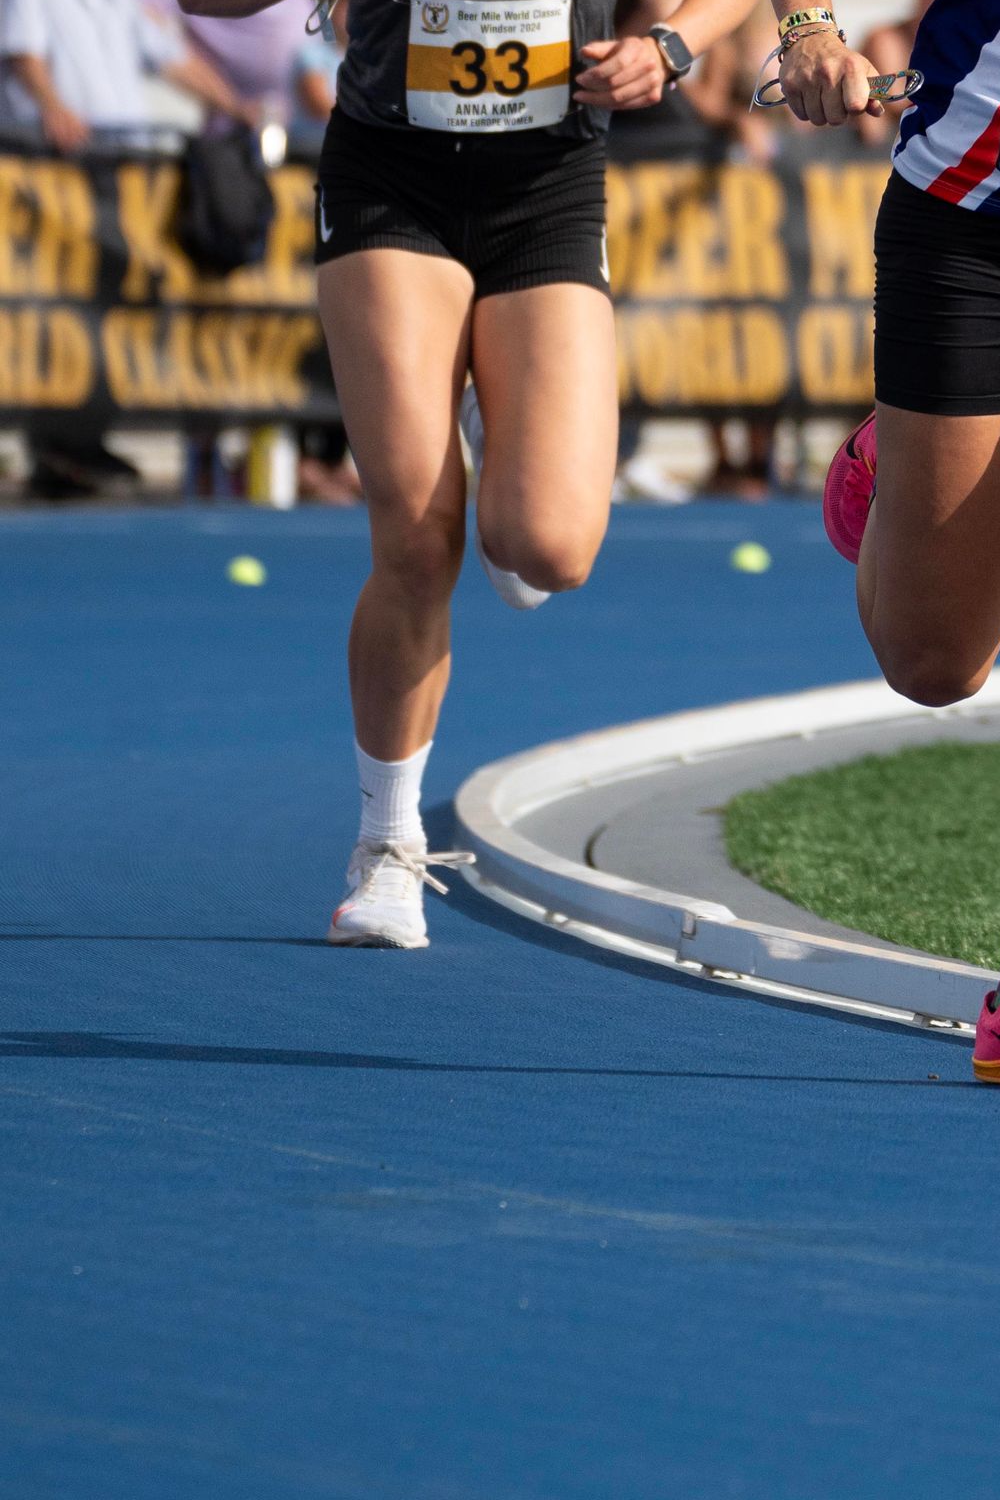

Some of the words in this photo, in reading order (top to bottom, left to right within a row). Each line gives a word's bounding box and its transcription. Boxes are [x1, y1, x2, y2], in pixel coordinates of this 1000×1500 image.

[457, 10, 478, 21] Beer
[481, 11, 501, 21] Mile
[504, 10, 530, 21] World
[480, 23, 517, 34] Windsor
[520, 22, 541, 33] 2024
[449, 40, 530, 98] 33
[455, 102, 487, 116] ANNA
[491, 101, 526, 116] KAMP
[447, 117, 468, 127] TEAM
[470, 116, 502, 127] EUROPE
[503, 115, 534, 126] WOMEN
